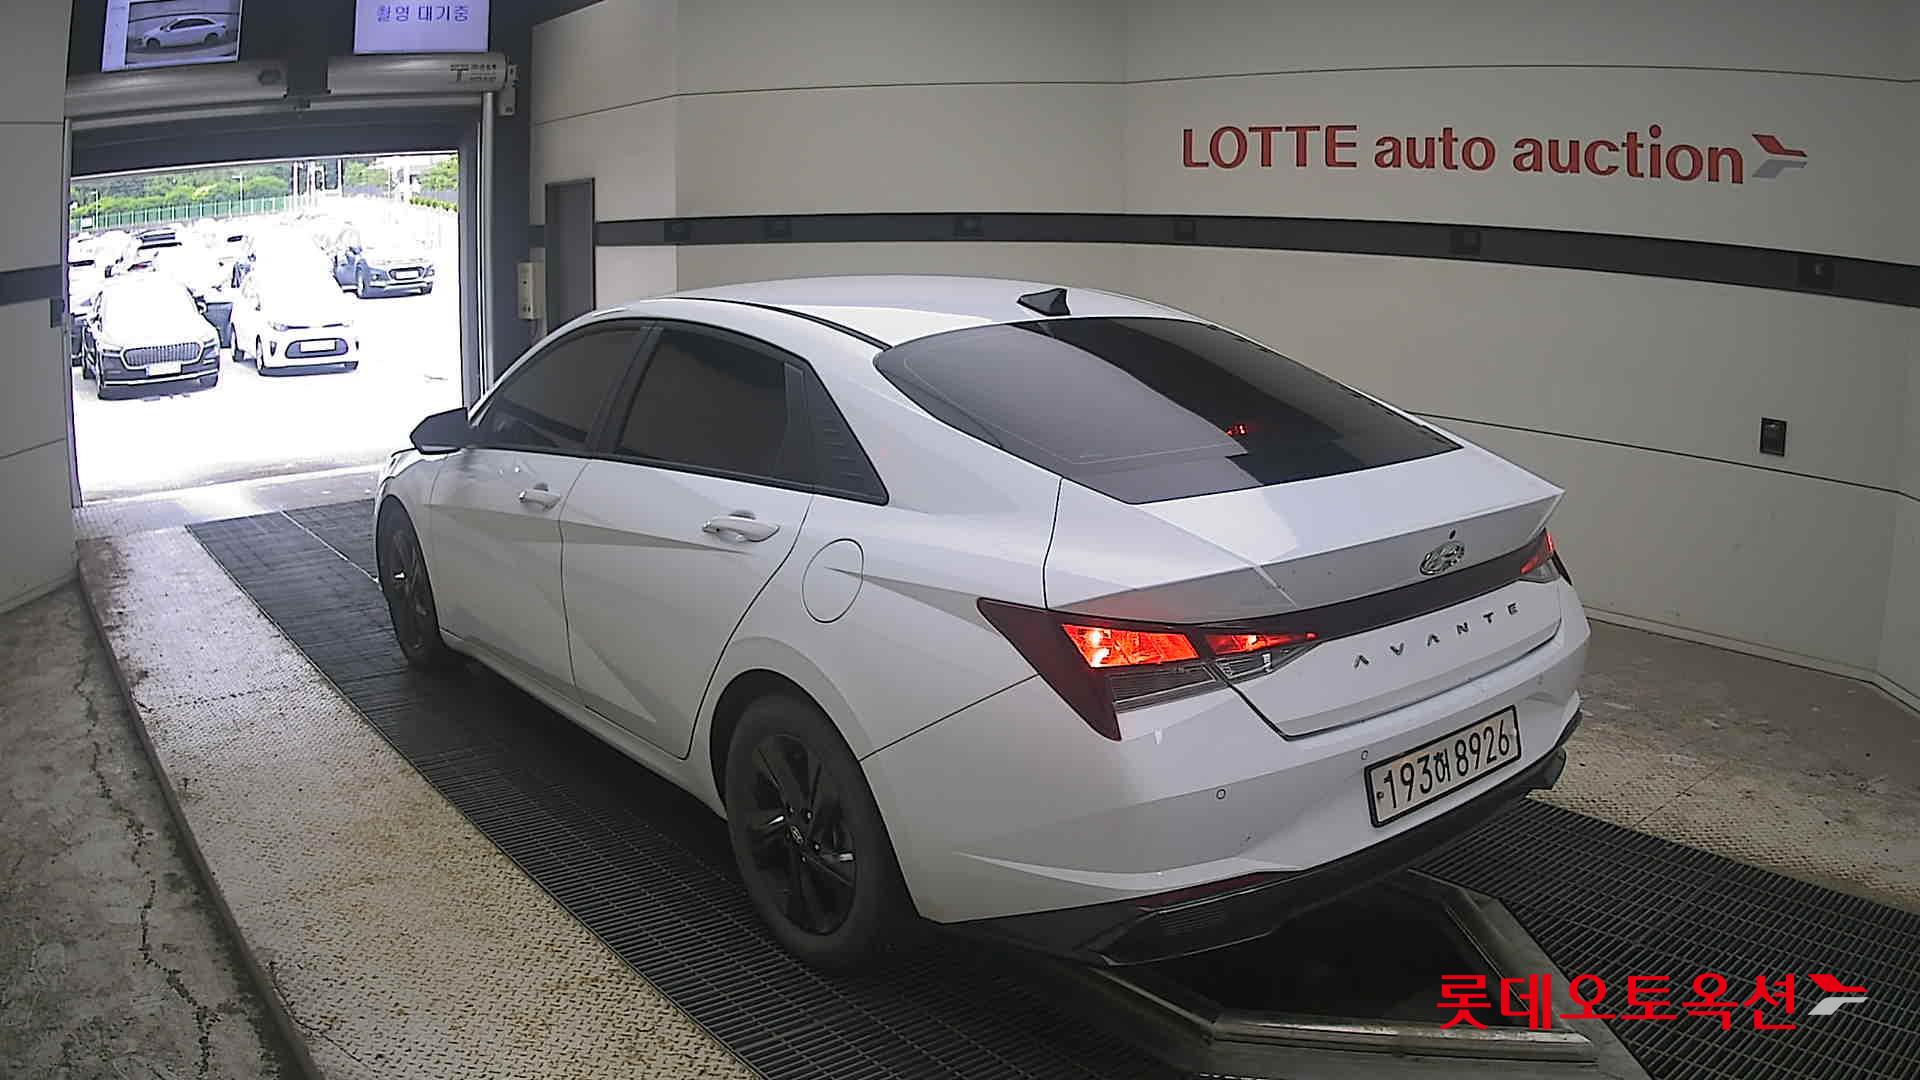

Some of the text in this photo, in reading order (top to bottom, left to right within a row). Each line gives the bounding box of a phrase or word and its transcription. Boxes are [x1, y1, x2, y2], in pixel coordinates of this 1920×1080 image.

[418, 6, 469, 22] 대기중
[1183, 124, 1744, 184] LOTTE auto auction
[1353, 603, 1519, 669] AVANTE
